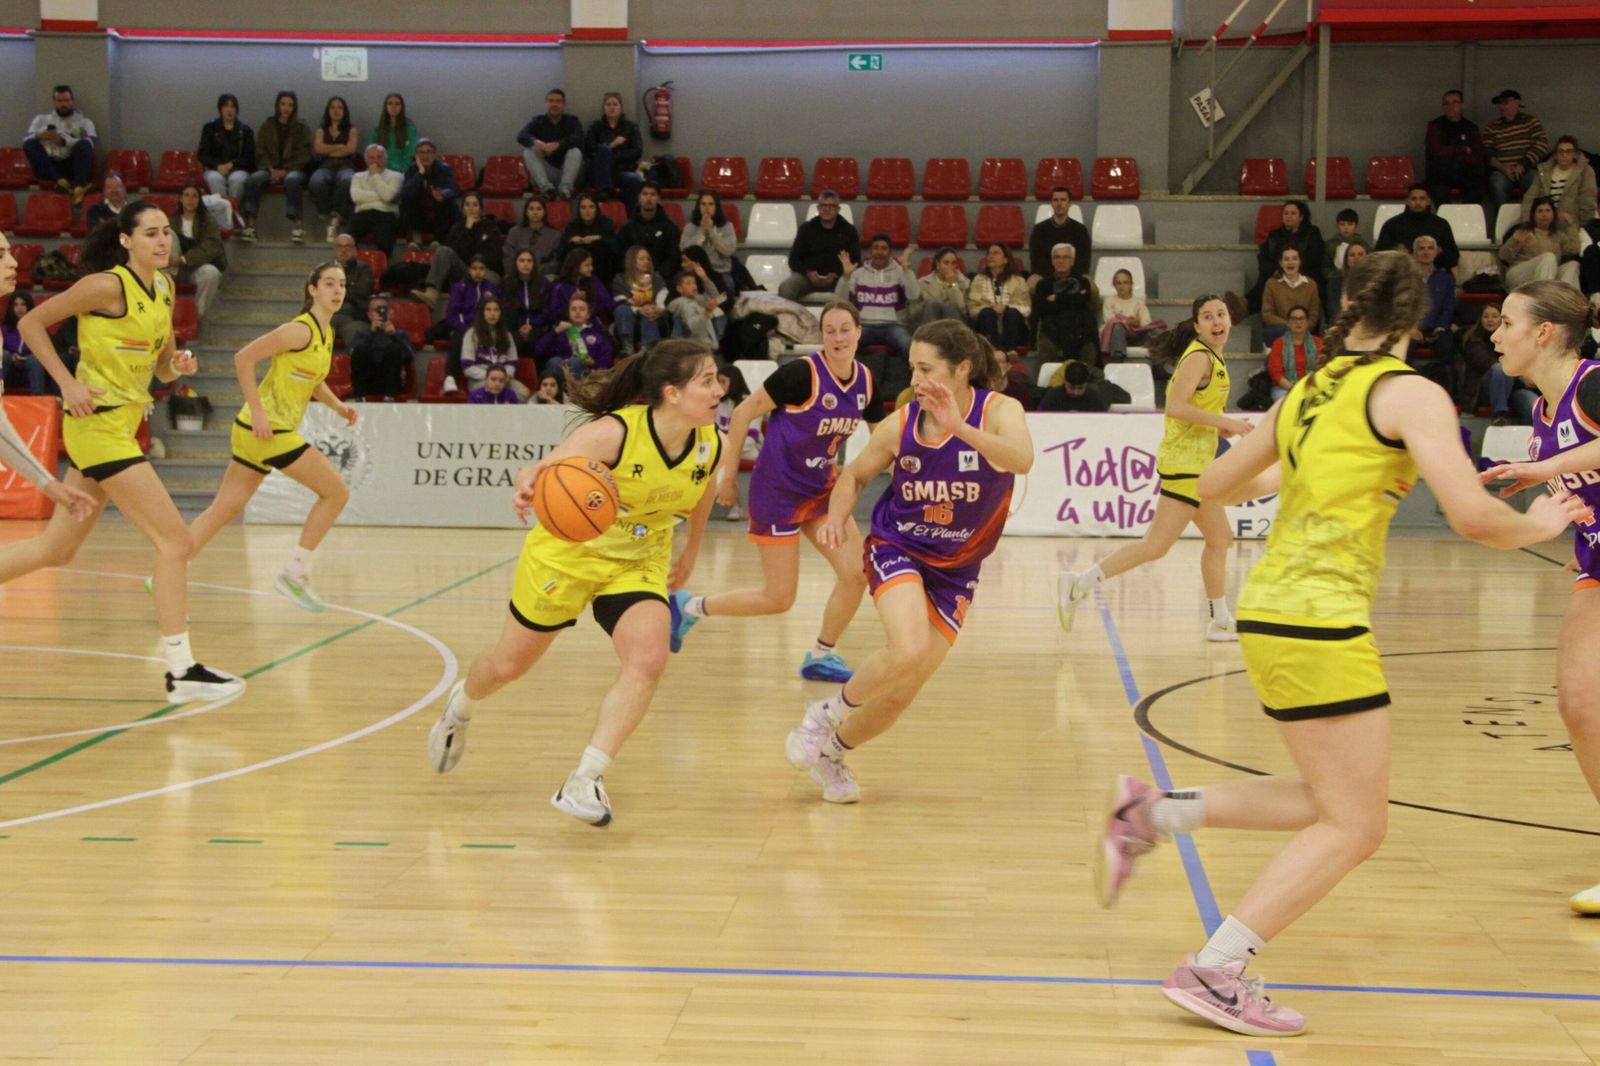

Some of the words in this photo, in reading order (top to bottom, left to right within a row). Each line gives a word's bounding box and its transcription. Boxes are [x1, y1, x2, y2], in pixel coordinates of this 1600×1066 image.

[414, 468, 447, 486] DE
[453, 466, 522, 487] GRA
[901, 480, 981, 502] GMASB
[922, 500, 954, 526] 16
